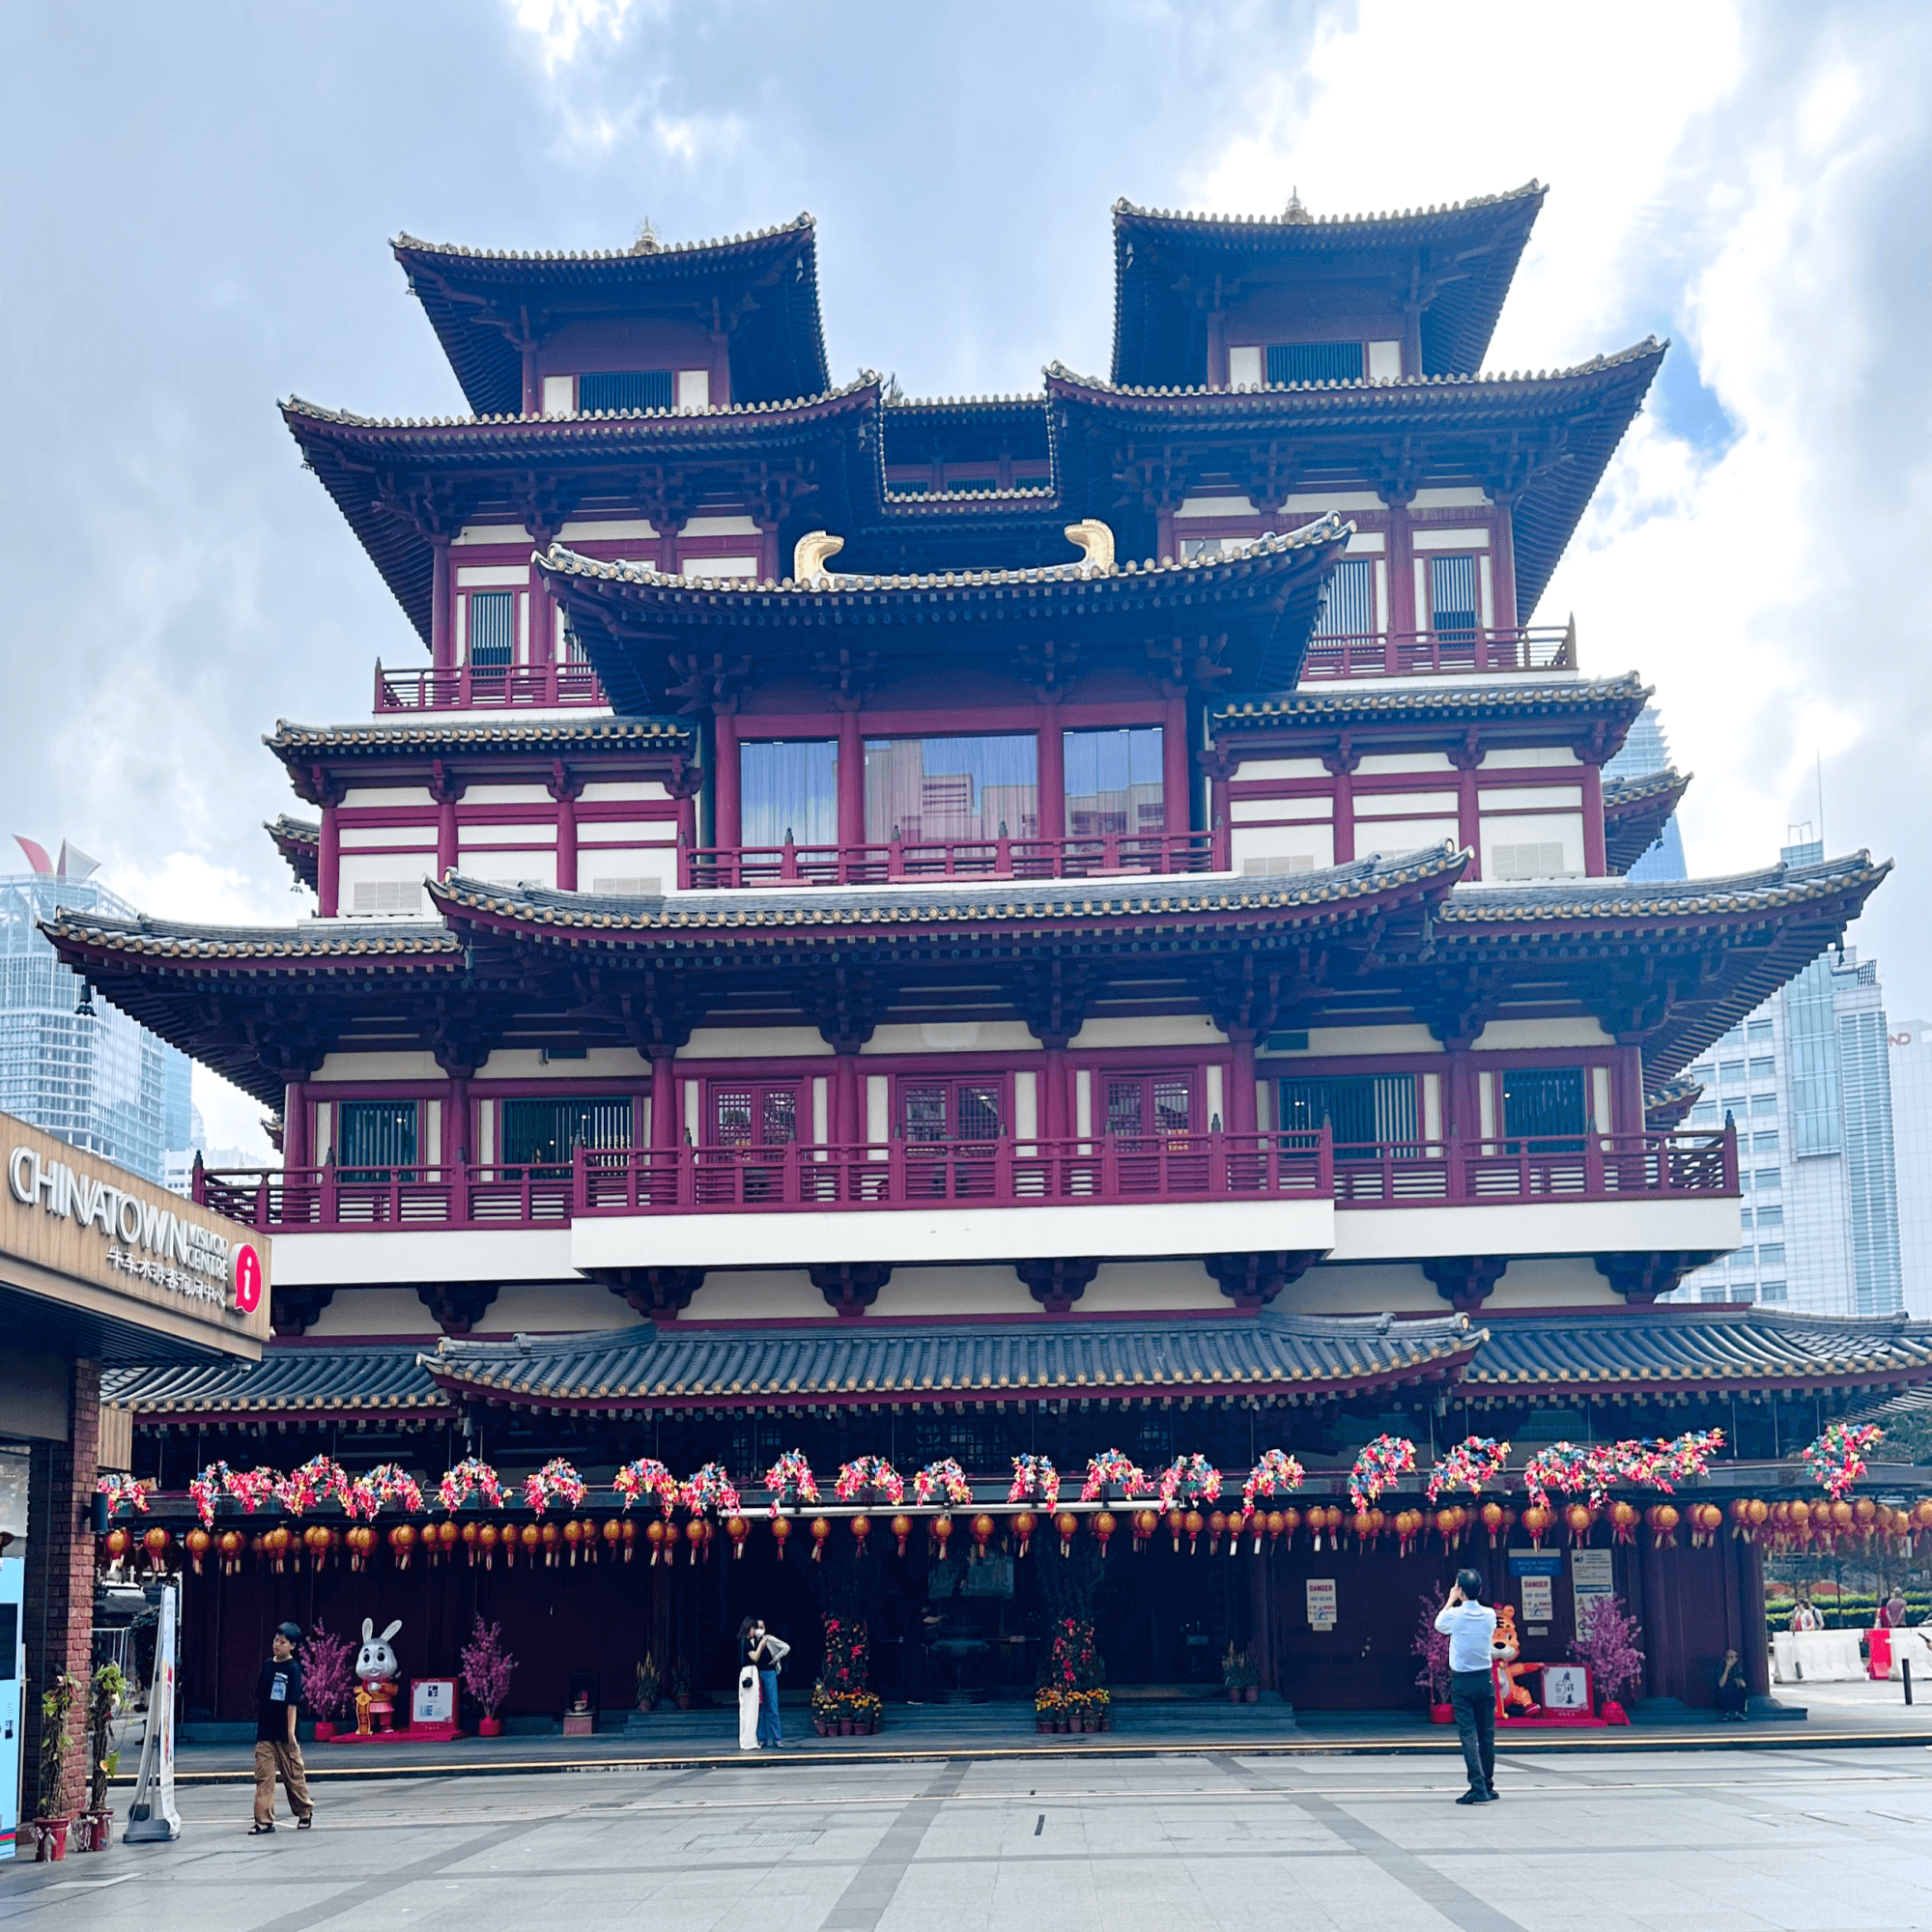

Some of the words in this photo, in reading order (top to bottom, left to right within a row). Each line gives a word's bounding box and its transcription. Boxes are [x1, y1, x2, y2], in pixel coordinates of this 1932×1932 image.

[9, 1147, 187, 1264] CHINATOWN
[186, 1244, 229, 1281] CENTRE
[187, 1223, 229, 1258] VISITOR
[106, 1244, 227, 1308] 牛车水游客询问中心
